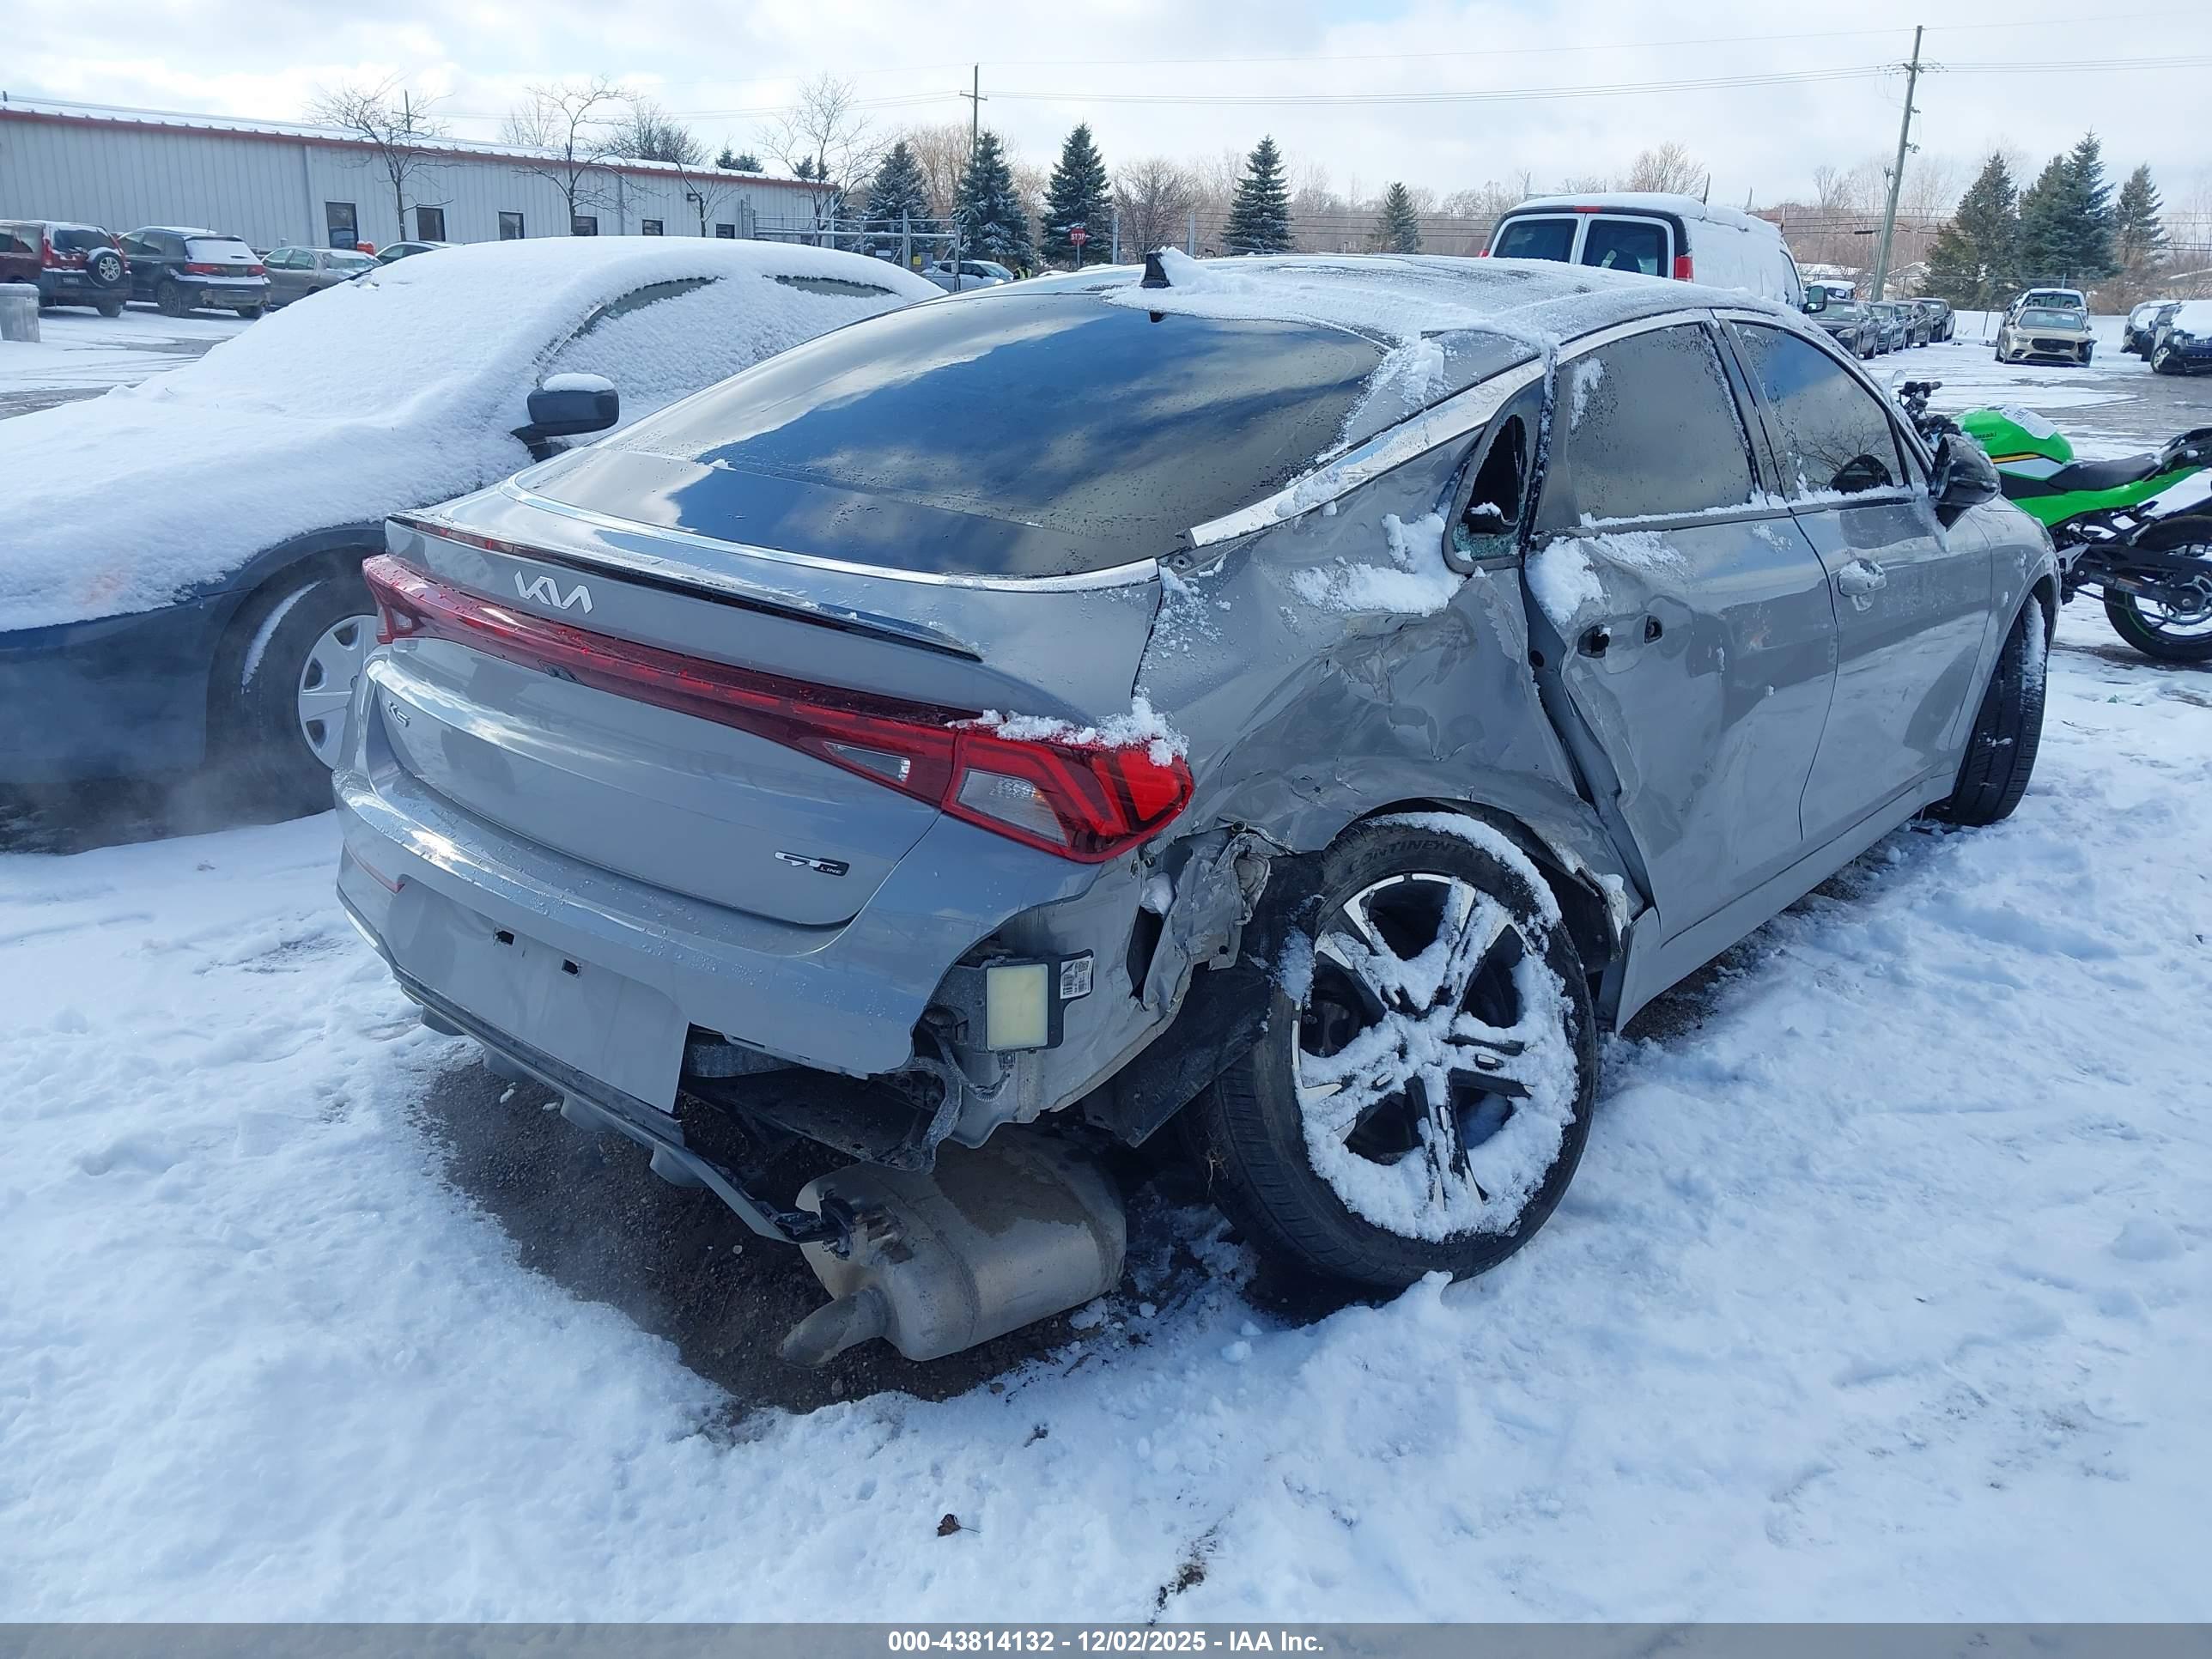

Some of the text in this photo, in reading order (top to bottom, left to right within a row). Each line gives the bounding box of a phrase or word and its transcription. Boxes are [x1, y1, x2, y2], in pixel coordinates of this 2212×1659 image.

[514, 569, 594, 615] KIA
[388, 700, 411, 727] K5
[819, 866, 843, 875] LINE
